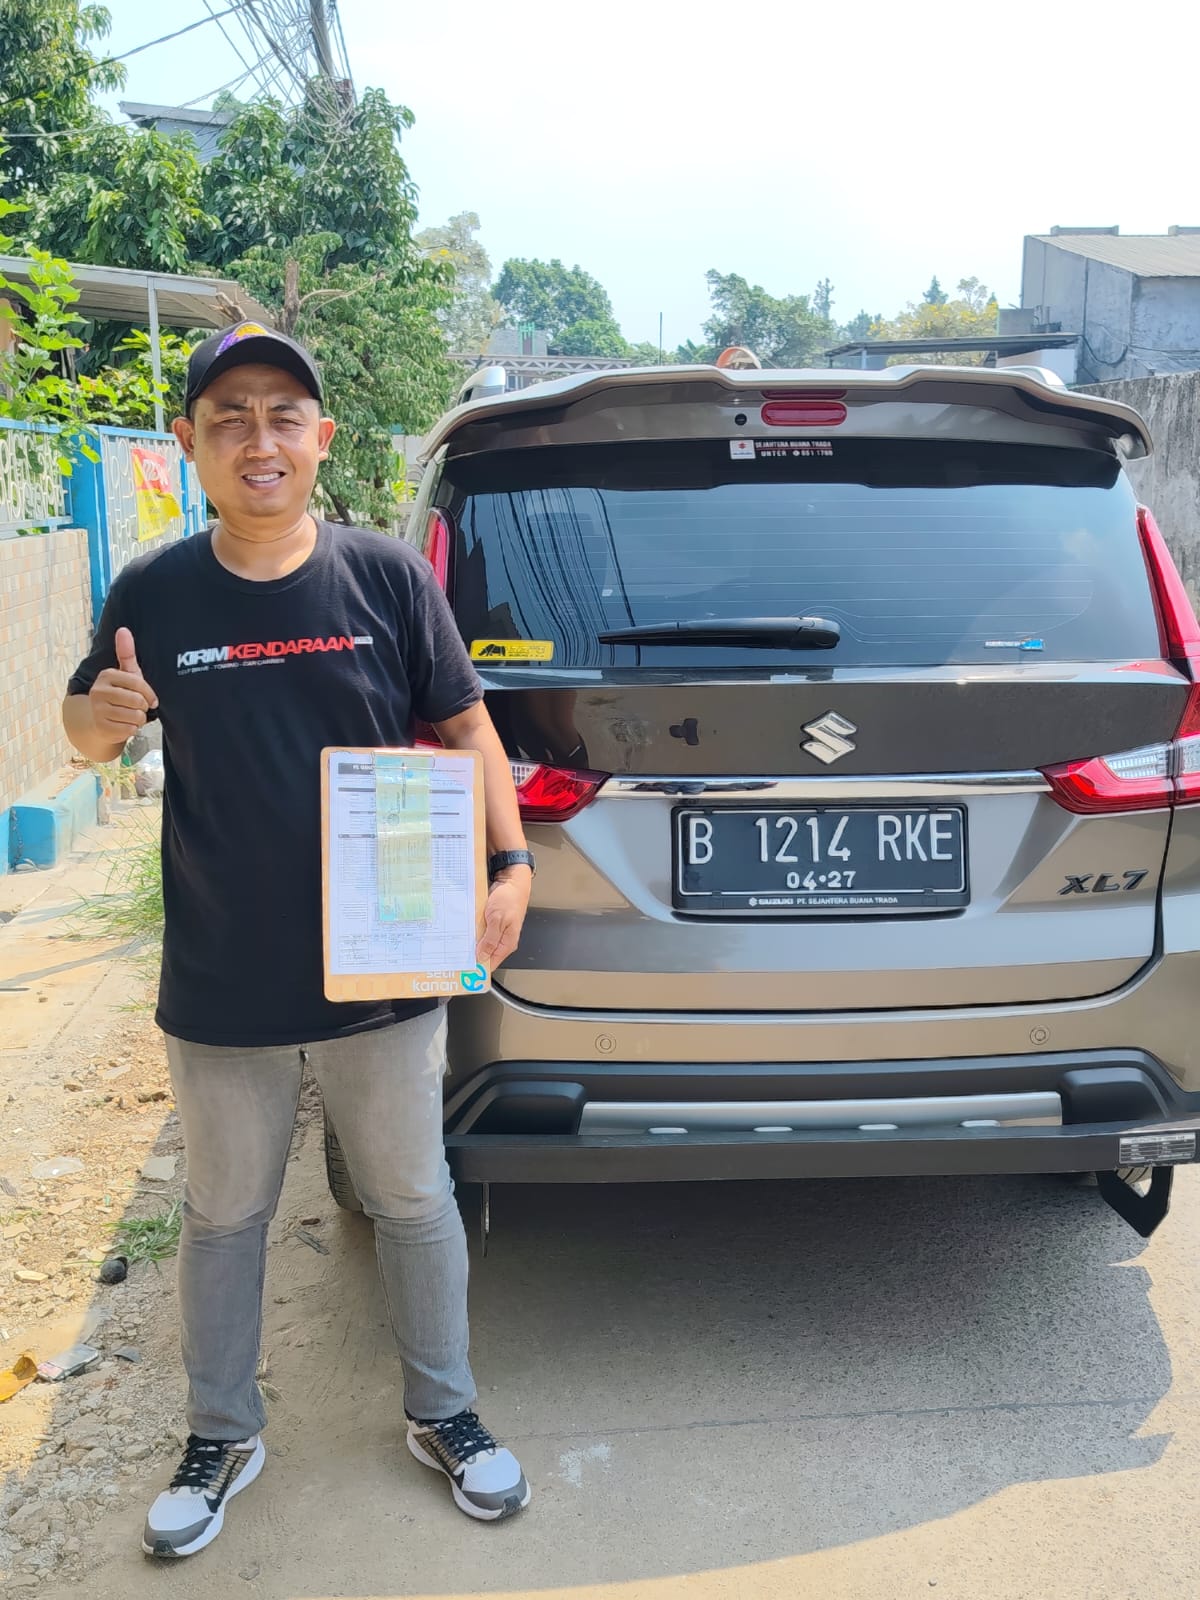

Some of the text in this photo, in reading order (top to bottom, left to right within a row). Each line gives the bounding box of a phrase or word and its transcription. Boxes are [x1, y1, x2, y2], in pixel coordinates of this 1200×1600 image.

[688, 813, 953, 865] B 1214 RKE
[1056, 868, 1150, 895] XL7
[412, 978, 458, 993] kanan
